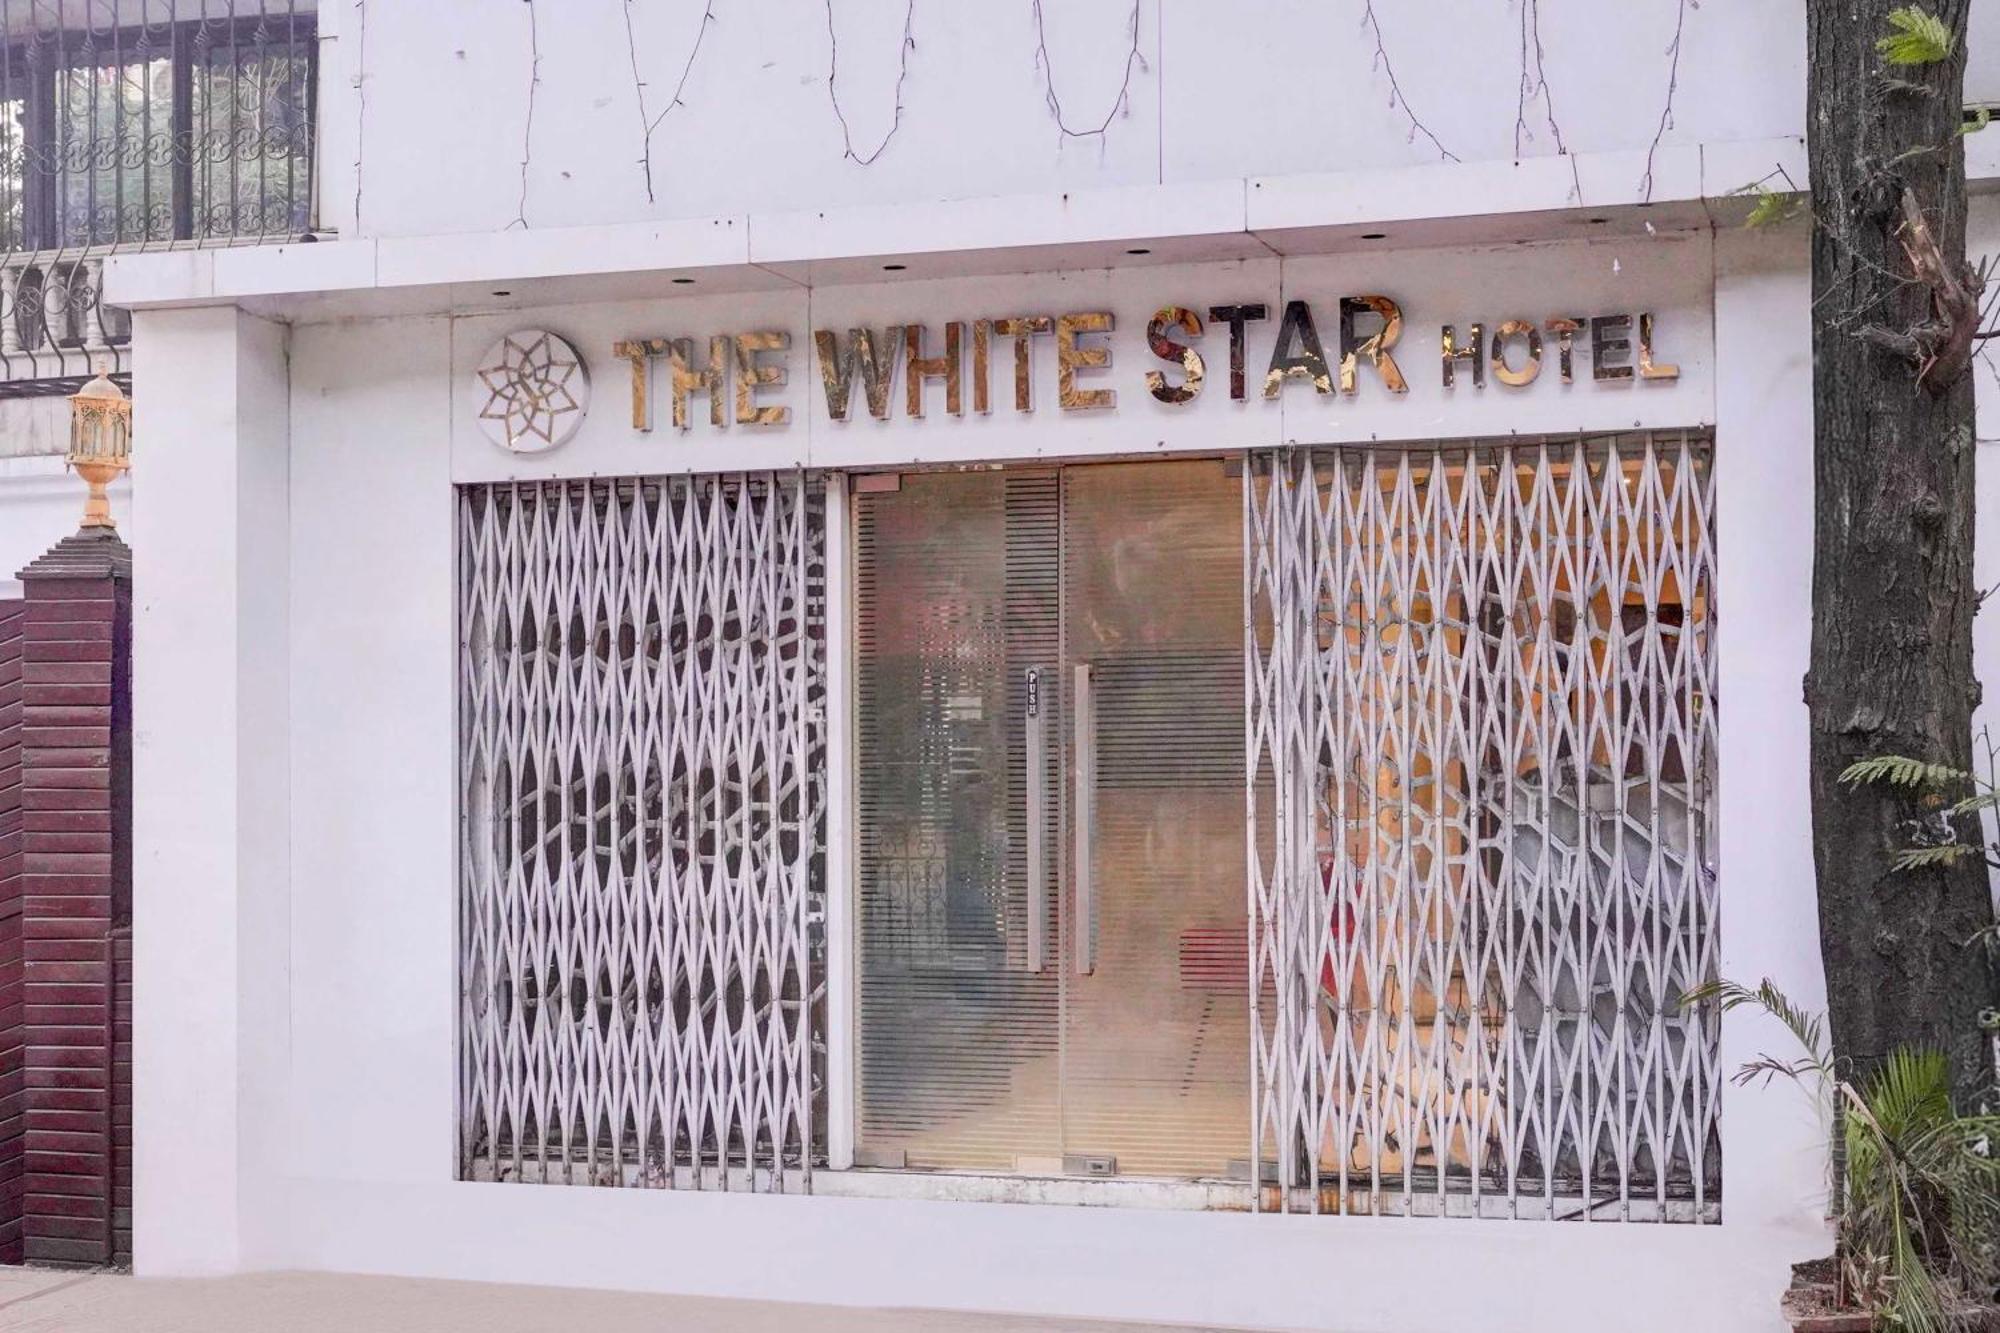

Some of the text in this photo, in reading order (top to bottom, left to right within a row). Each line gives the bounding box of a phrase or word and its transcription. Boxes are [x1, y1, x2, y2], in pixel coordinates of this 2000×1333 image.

[613, 295, 1680, 431] THE WHITE STAR HOTEL
[1028, 671, 1037, 714] PUSH
